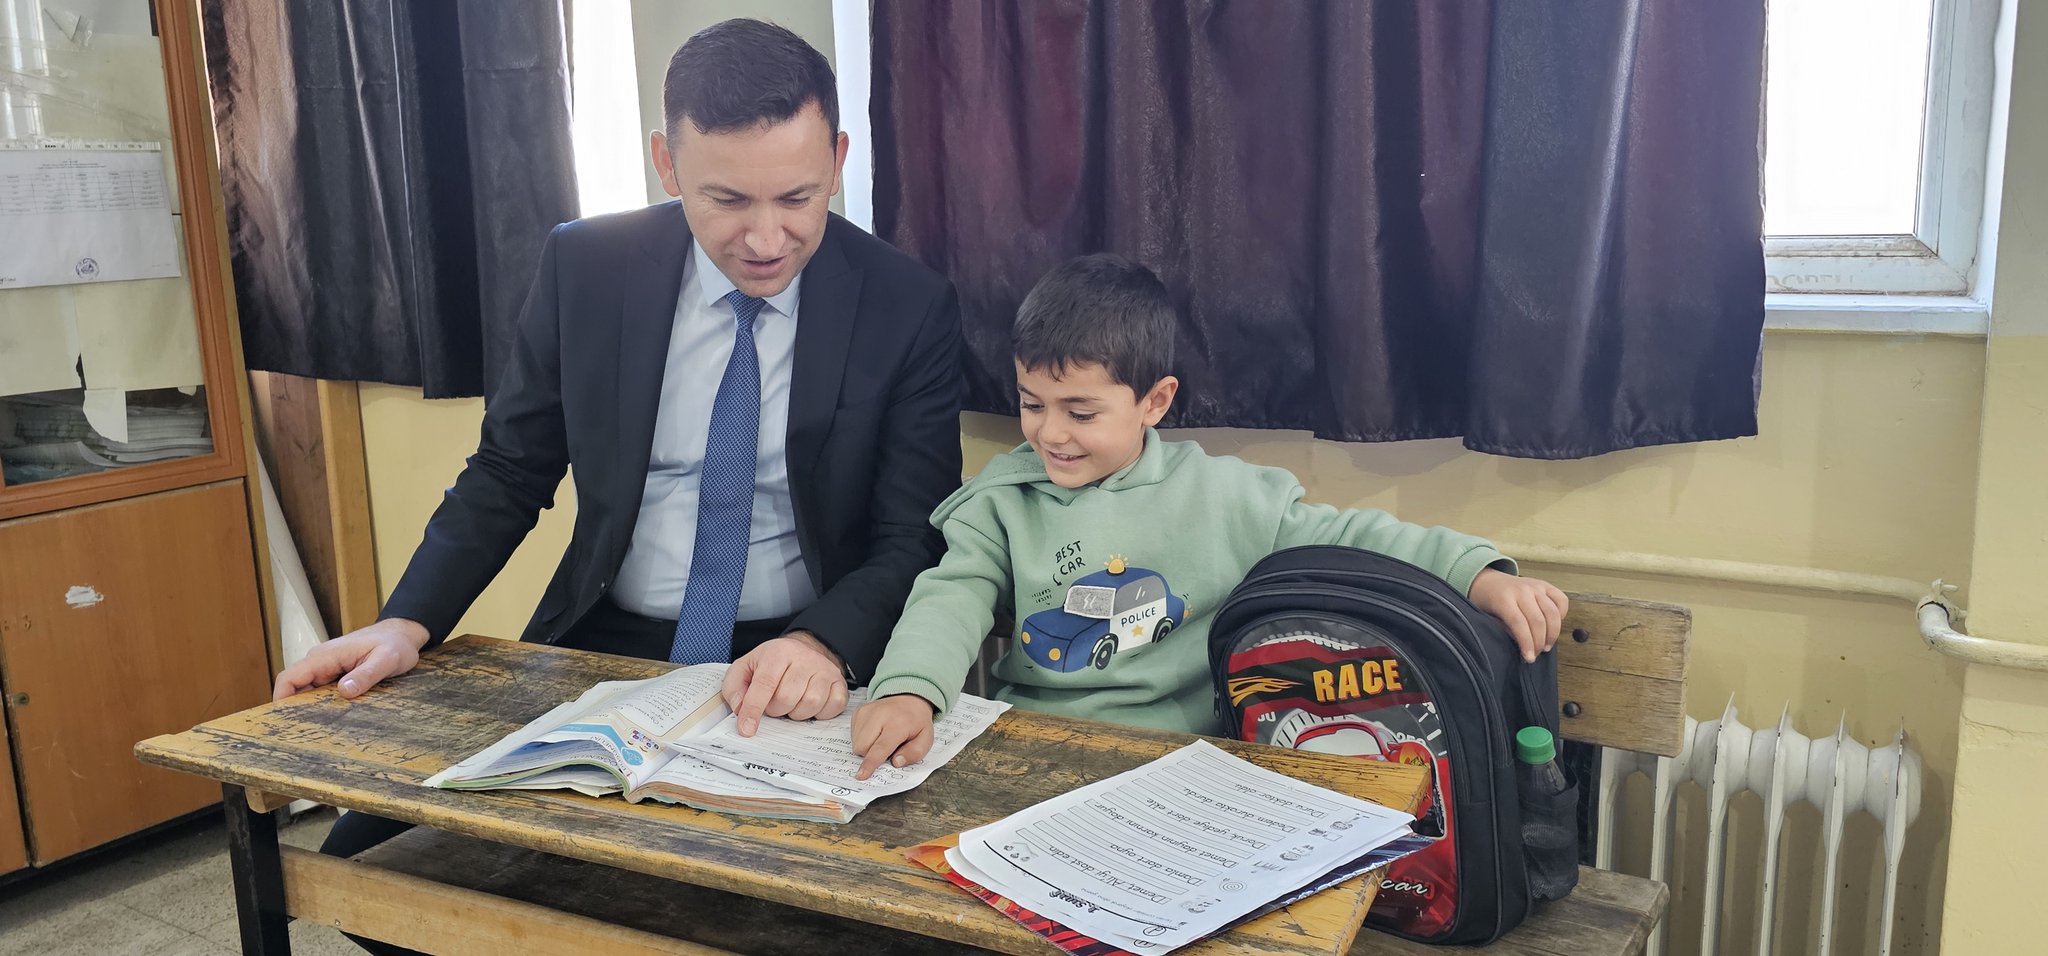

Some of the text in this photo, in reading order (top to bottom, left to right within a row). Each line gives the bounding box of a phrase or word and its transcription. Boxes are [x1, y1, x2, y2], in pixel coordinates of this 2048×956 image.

[1055, 540, 1082, 563] BEST
[1059, 556, 1086, 576] CAR
[1120, 606, 1157, 627] POLICE
[1312, 659, 1404, 702] RACE
[1259, 793, 1293, 807] doktor
[1215, 802, 1255, 819] durakta
[1295, 804, 1325, 818] Duru
[1192, 821, 1231, 836] yediye
[1257, 816, 1296, 833] Dedem
[1230, 833, 1267, 850] Doruk
[1070, 858, 1095, 873] dost
[1137, 856, 1163, 870] dart
[1199, 851, 1237, 869] Demet
[1164, 867, 1203, 887] Damla
[1380, 879, 1428, 895] car
